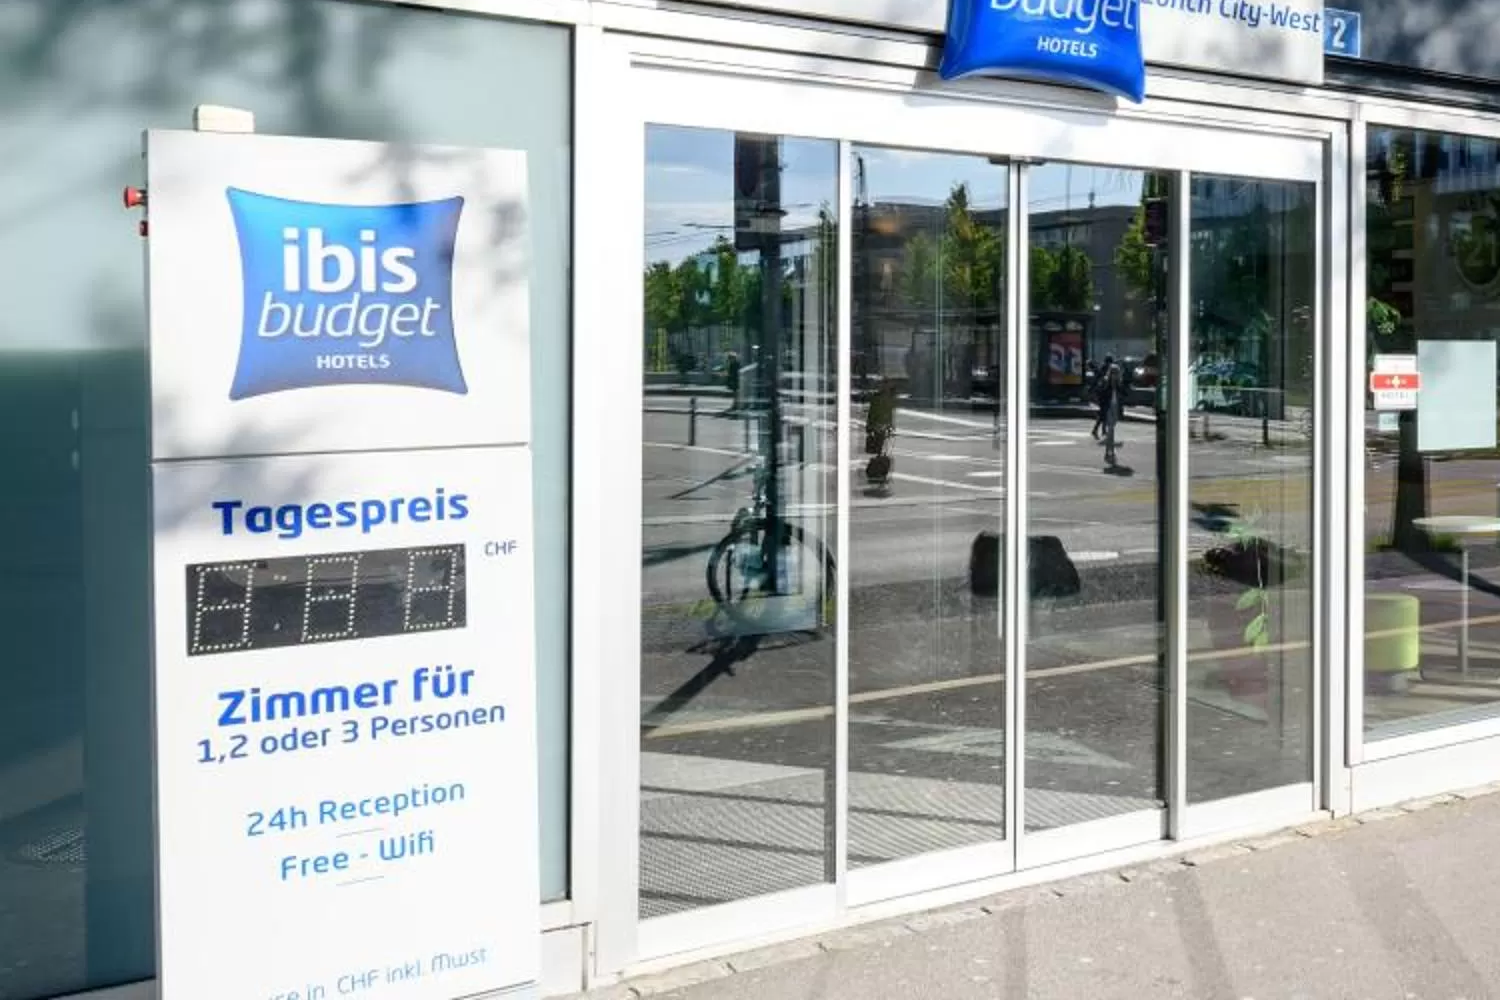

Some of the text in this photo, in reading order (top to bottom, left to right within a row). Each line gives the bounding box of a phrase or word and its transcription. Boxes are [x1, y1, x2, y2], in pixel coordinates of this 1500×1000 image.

[1036, 34, 1099, 59] HOTELS
[1330, 18, 1345, 48] 2
[283, 227, 417, 293] ibis
[257, 291, 441, 348] budget
[316, 353, 391, 369] HOTELS
[212, 488, 470, 538] Tagespreis
[484, 540, 518, 557] CHF
[217, 664, 475, 726] Zimmer für
[197, 704, 506, 764] 1,2 oder 3 Personen
[246, 782, 466, 837] 24h Reception
[281, 849, 350, 881] Free
[379, 830, 436, 861] Wifi
[337, 969, 379, 994] CHF
[431, 948, 487, 972] Mwst
